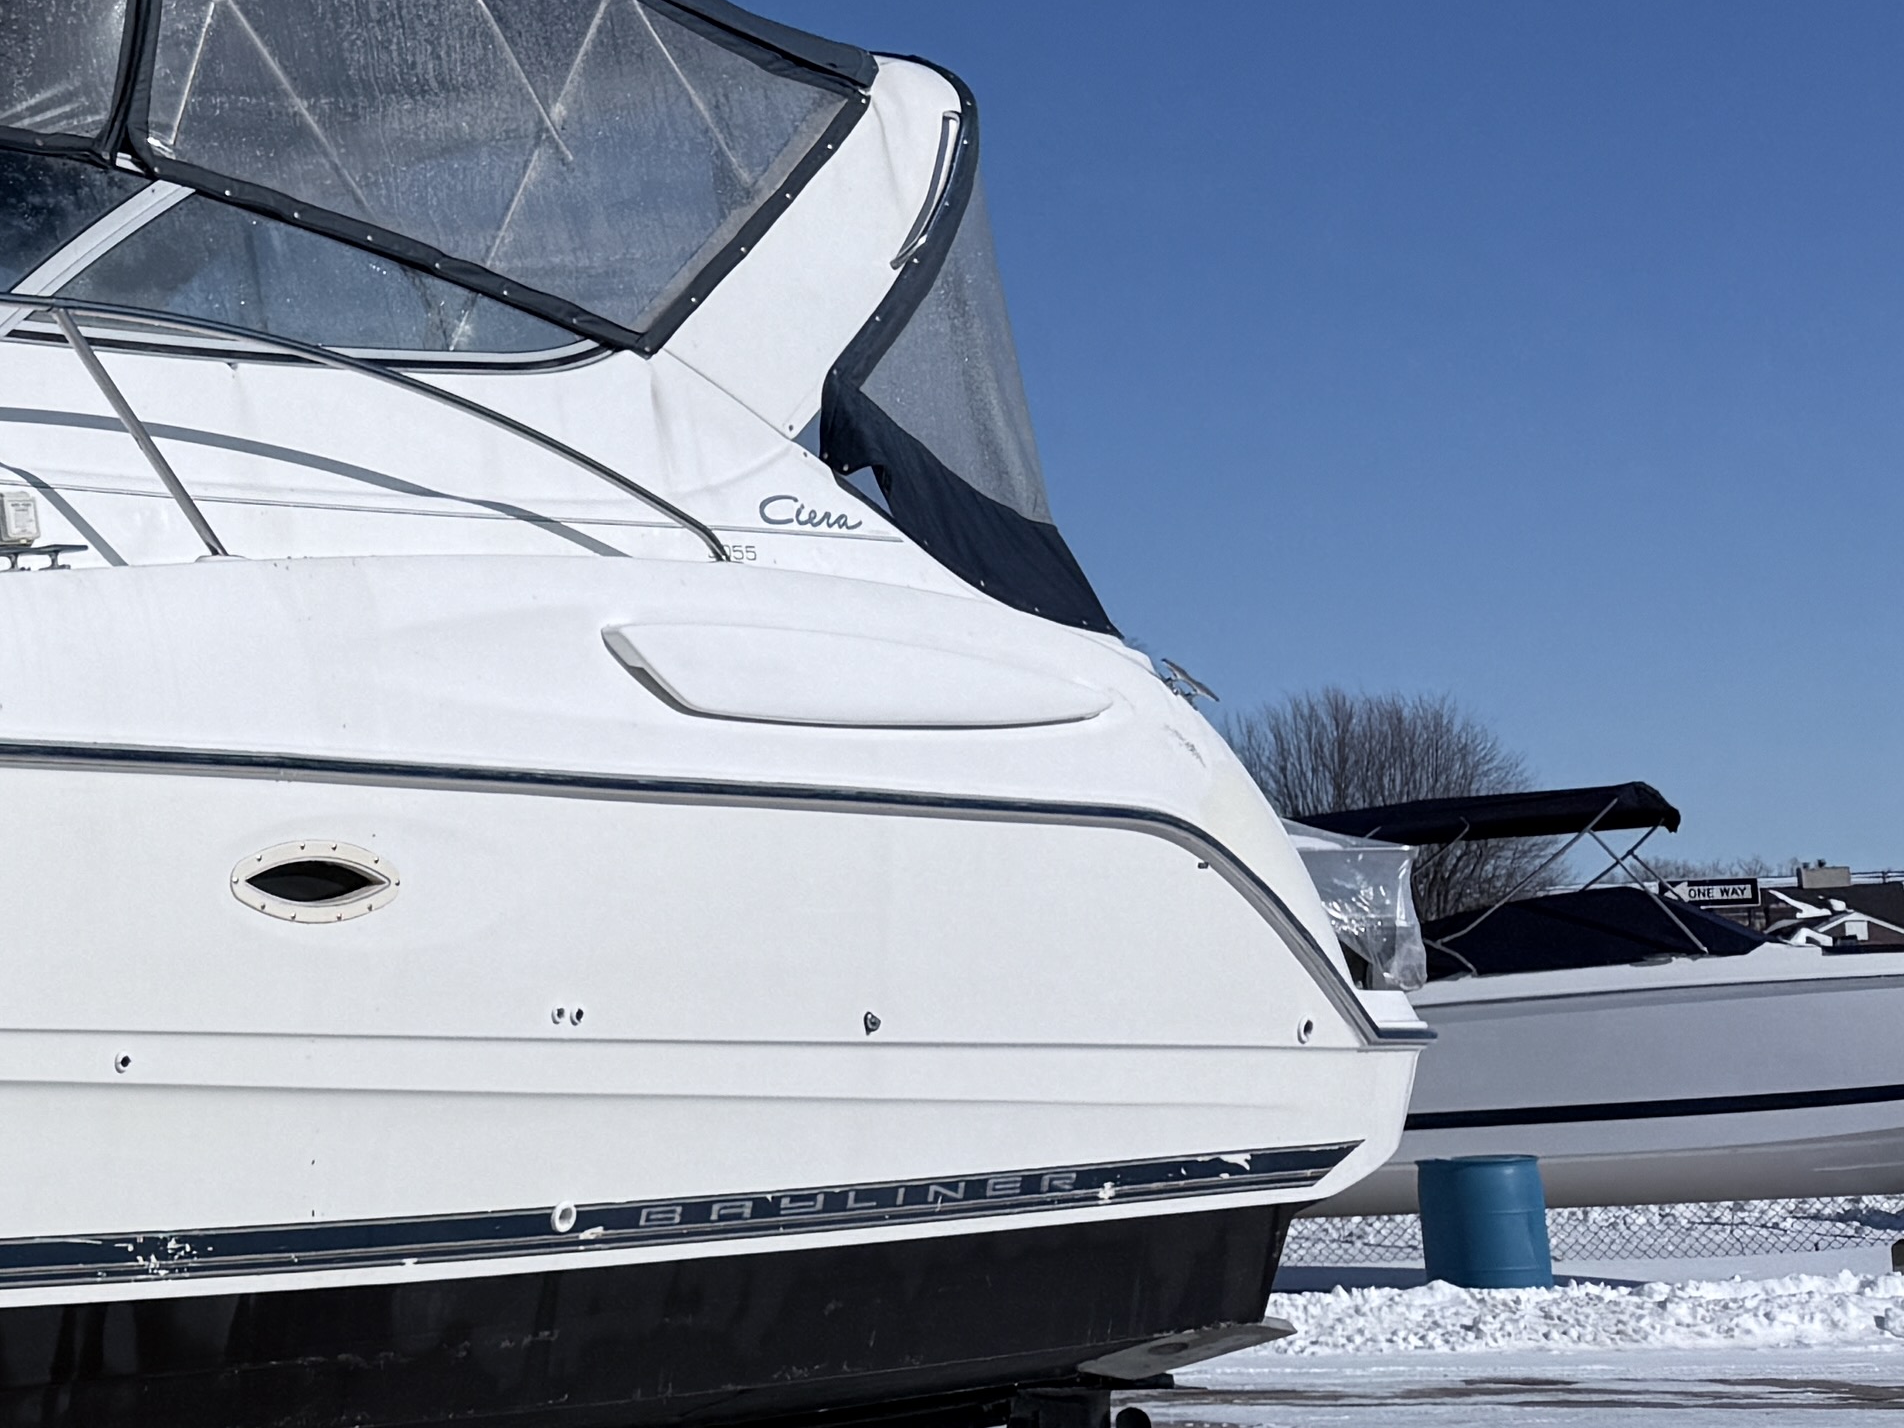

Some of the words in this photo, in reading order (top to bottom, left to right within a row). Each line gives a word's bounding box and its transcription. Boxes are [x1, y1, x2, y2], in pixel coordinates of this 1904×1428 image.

[759, 495, 863, 530] Ciera
[1688, 887, 1714, 899] ONE
[1719, 886, 1747, 898] WAY
[639, 1172, 1077, 1227] BAYLINER
